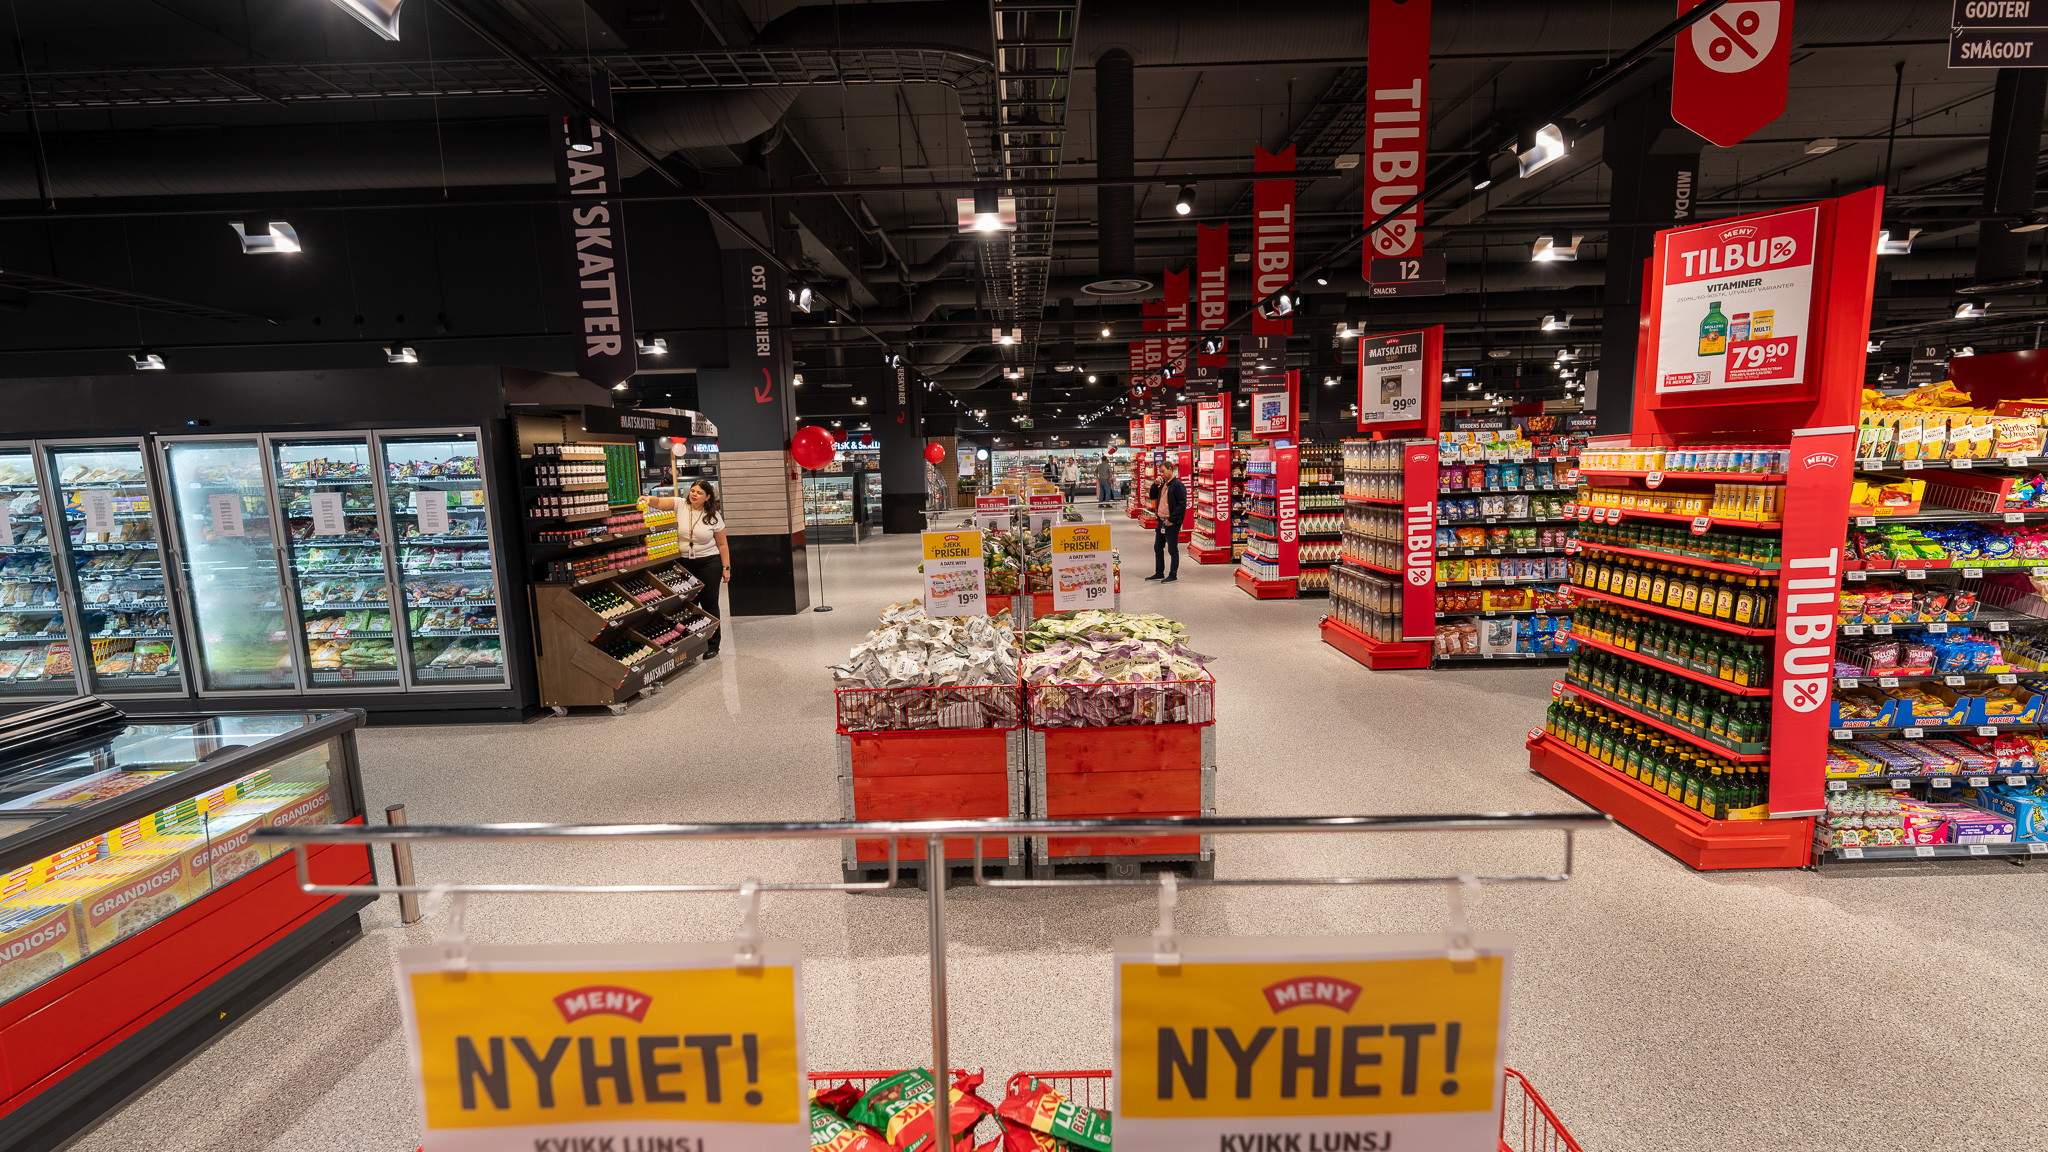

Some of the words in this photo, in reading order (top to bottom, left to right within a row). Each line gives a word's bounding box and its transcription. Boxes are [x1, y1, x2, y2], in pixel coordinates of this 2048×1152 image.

[1965, 1, 2030, 18] GODTERI
[1960, 40, 2034, 59] SMÅGODT
[1722, 227, 1754, 240] MENY
[1400, 260, 1420, 280] 12
[751, 265, 767, 290] OST
[1373, 287, 1397, 295] SNACKS
[1707, 278, 1762, 293] VITAMINER
[1729, 287, 1757, 296] UTVALGT
[1758, 282, 1795, 292] VARIANTER
[753, 294, 767, 307] &
[1753, 325, 1771, 333] MULTI
[1258, 336, 1268, 348] 11
[1368, 343, 1418, 358] MATSKATTER
[1926, 347, 1936, 357] 10
[1197, 367, 1207, 376] 10
[1381, 364, 1403, 372] EPLEMOST
[1894, 366, 1900, 374] 3
[1161, 387, 1167, 395] 9
[621, 415, 656, 430] MATSKATTER
[2000, 423, 2037, 432] Werther's
[834, 441, 850, 450] FISK
[850, 441, 858, 449] &
[1805, 453, 1835, 467] MENY
[1874, 508, 1893, 516] bilar
[943, 541, 962, 549] SJEKK
[1063, 541, 1099, 552] PRISEN!
[934, 547, 970, 558] PRISEN!
[1909, 650, 1933, 660] HALLON
[643, 658, 676, 686] MATSKATTER
[1842, 720, 1870, 728] HARIBO
[1915, 718, 1942, 726] HARIBO
[1987, 716, 2015, 724] HARIBO
[272, 792, 331, 828] GRANDIOSA
[91, 866, 180, 917] GRANDIOSA
[1275, 981, 1353, 1008] MENY
[563, 990, 643, 1015] MENY
[1156, 1021, 1462, 1101] NYHET!
[455, 1033, 763, 1111] NYHET!
[1220, 1131, 1304, 1152] KVIKK
[1309, 1130, 1392, 1152] LUNSJ
